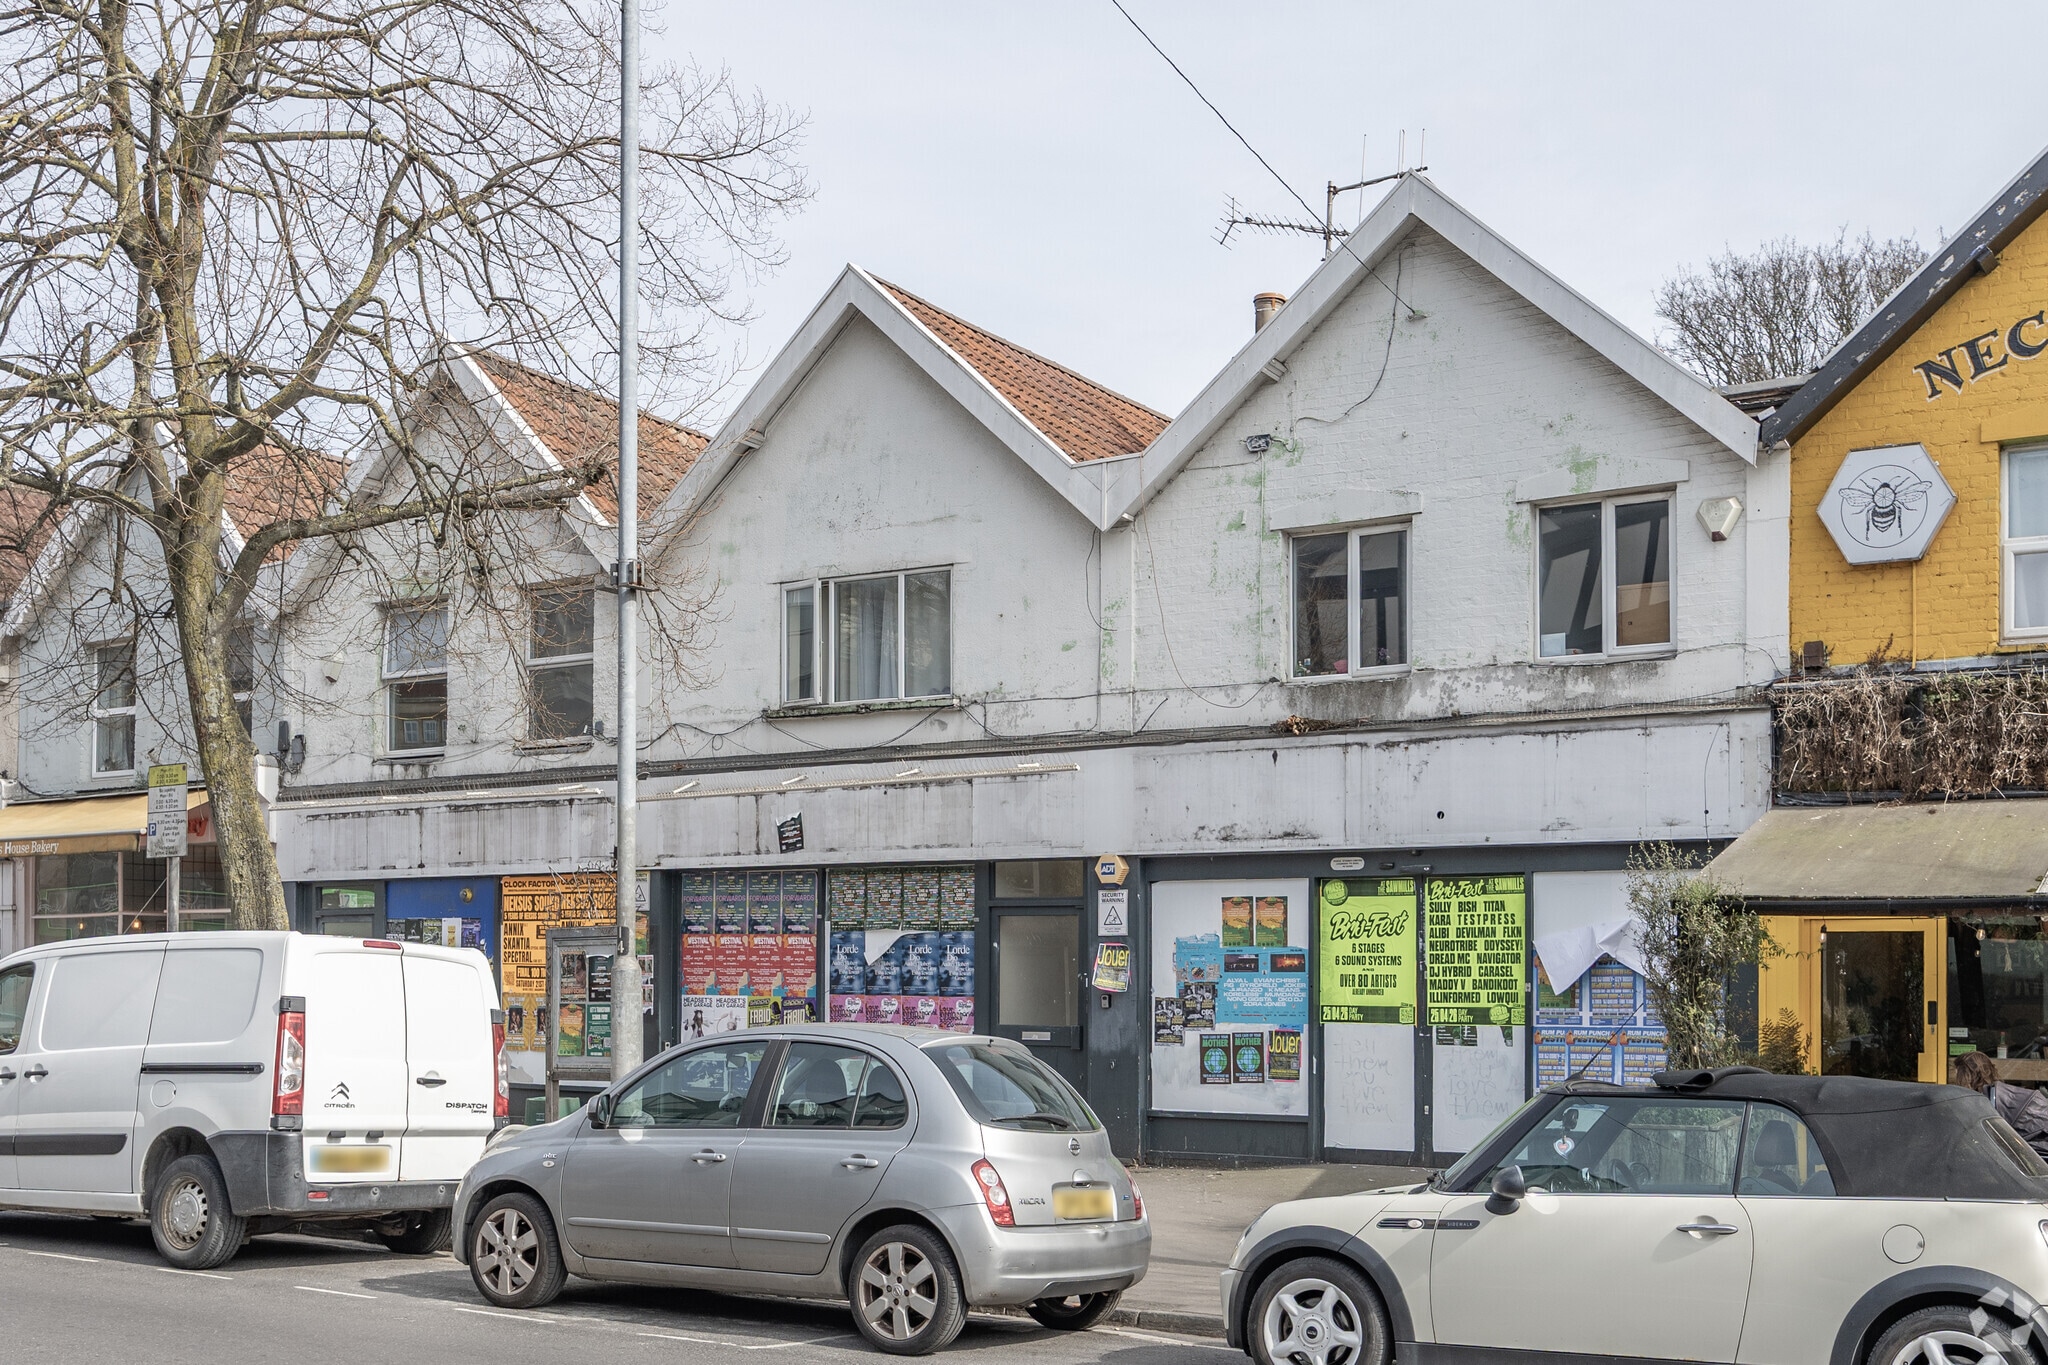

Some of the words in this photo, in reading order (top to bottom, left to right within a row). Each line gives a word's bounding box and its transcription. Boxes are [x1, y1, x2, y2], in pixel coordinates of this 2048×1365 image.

[1912, 310, 2048, 402] NEC
[4, 842, 30, 854] House
[31, 840, 60, 854] Bakery
[1101, 864, 1114, 873] ADT
[1430, 879, 1484, 900] Bris-Fest
[1429, 902, 1452, 913] SULLY
[1458, 901, 1477, 912] BISH
[1484, 900, 1506, 912] TITAN
[1330, 910, 1409, 941] Bris-Fest
[1429, 914, 1452, 926] KARA
[504, 922, 524, 936] ANNIX
[1429, 927, 1450, 938] ALIBI
[1456, 926, 1496, 938] DEVILMAN
[1503, 926, 1522, 938] FLKN
[504, 938, 530, 950] SKANTIA
[837, 944, 858, 954] Lorde
[909, 944, 932, 954] Lorde
[946, 944, 970, 954] Lorde
[1352, 943, 1357, 954] 6
[1358, 943, 1385, 954] STAGES
[1429, 940, 1478, 952] NEUROTRIBE
[1484, 940, 1520, 951] ODYSSEY
[504, 951, 532, 963] SPECTRAL
[1098, 944, 1130, 967] Jouer
[1335, 956, 1340, 966] 6
[1342, 956, 1366, 966] SOUND
[1368, 956, 1402, 966] SYSTEMS
[1429, 952, 1456, 964] DREAD
[1457, 952, 1470, 964] MC
[1476, 952, 1522, 964] NAVIGATOR
[1429, 966, 1440, 977] DJ
[1442, 966, 1472, 977] HYBRID
[1478, 966, 1514, 977] CARASEL
[1340, 974, 1356, 988] OVER
[1358, 974, 1368, 988] 80
[1370, 974, 1397, 988] ARTISTS
[1429, 979, 1458, 990] MADDY
[1460, 979, 1466, 990] V
[1472, 979, 1518, 990] BANDIKOOT
[1429, 992, 1480, 1003] ILLINFORMED
[1486, 992, 1519, 1005] LOWQUI
[750, 1009, 771, 1024] FABIO
[1268, 1030, 1300, 1054] Jouer
